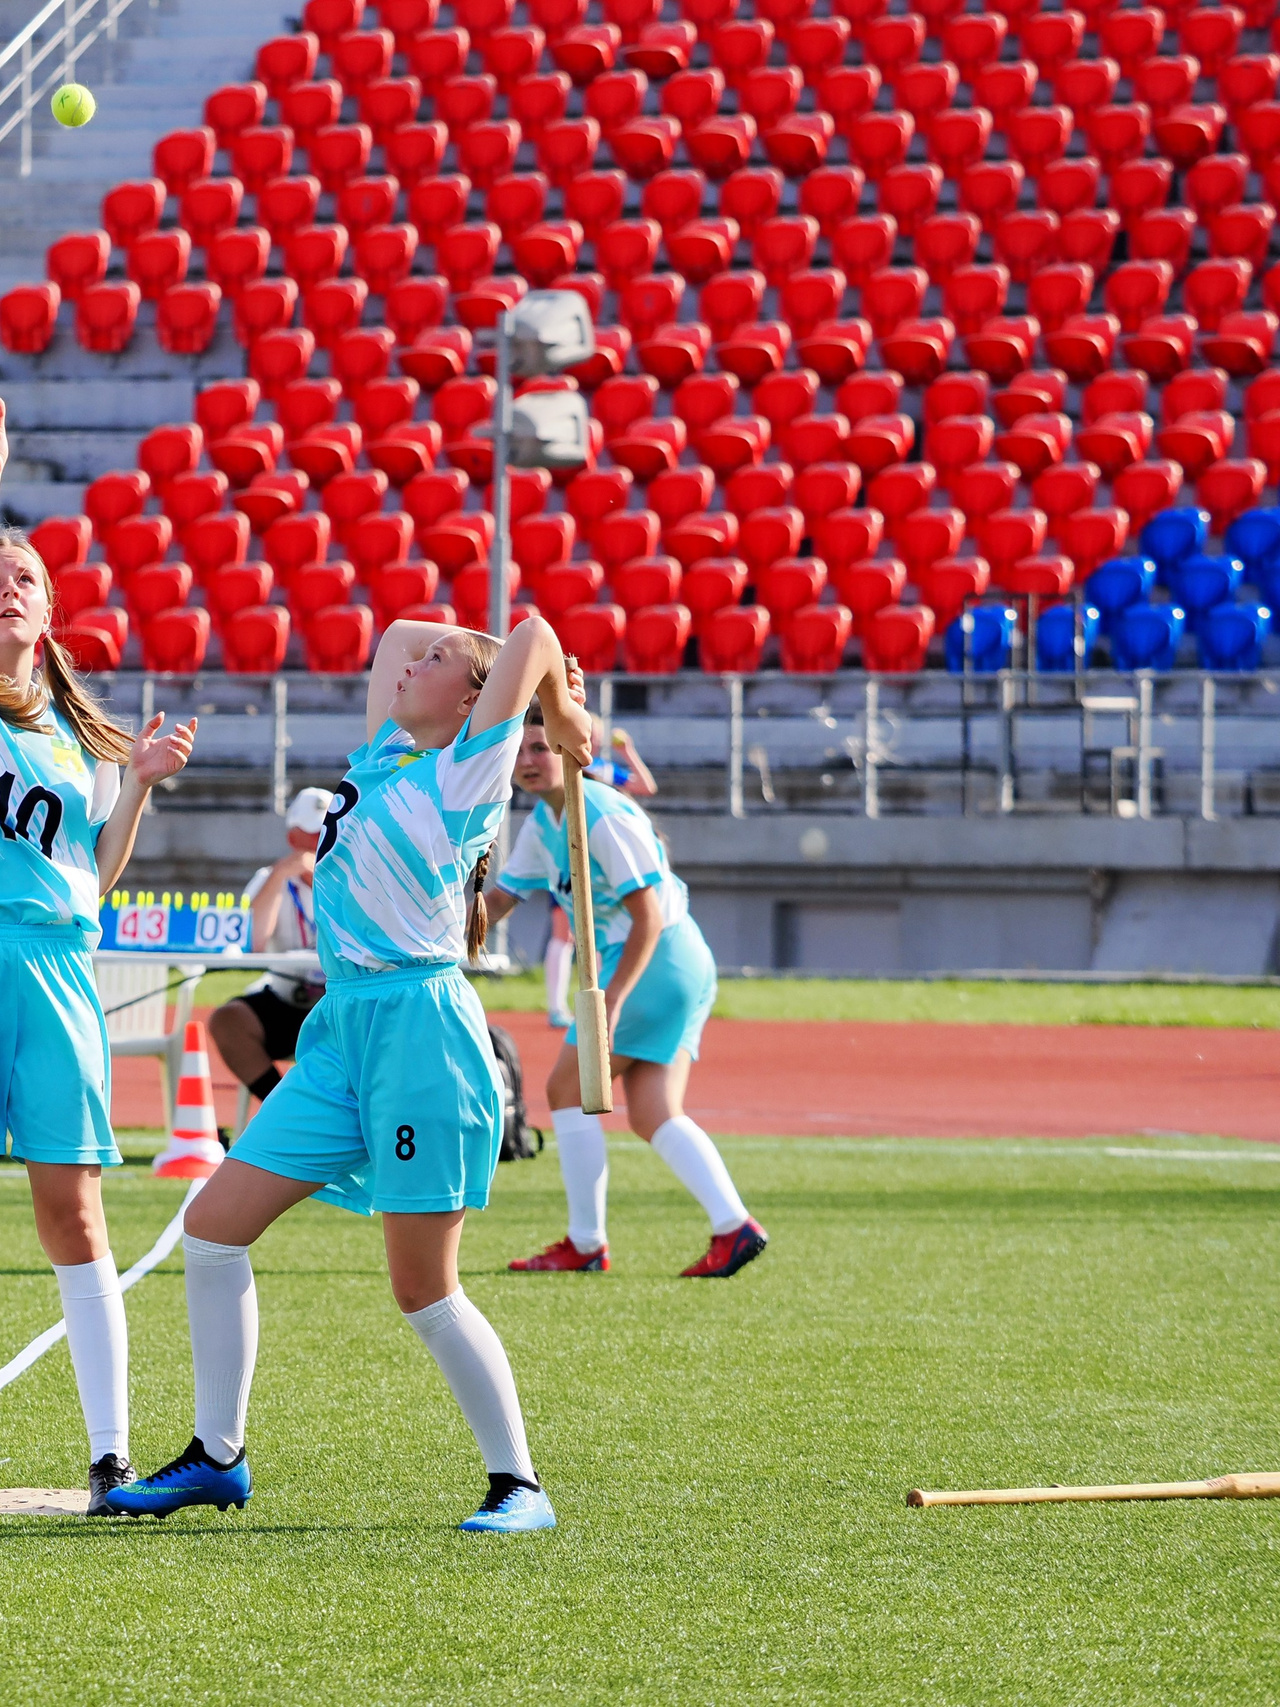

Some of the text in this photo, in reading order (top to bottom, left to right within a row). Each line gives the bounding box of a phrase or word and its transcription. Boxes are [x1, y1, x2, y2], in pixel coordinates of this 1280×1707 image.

[122, 909, 244, 943] 43 03
[395, 1124, 416, 1161] 8
